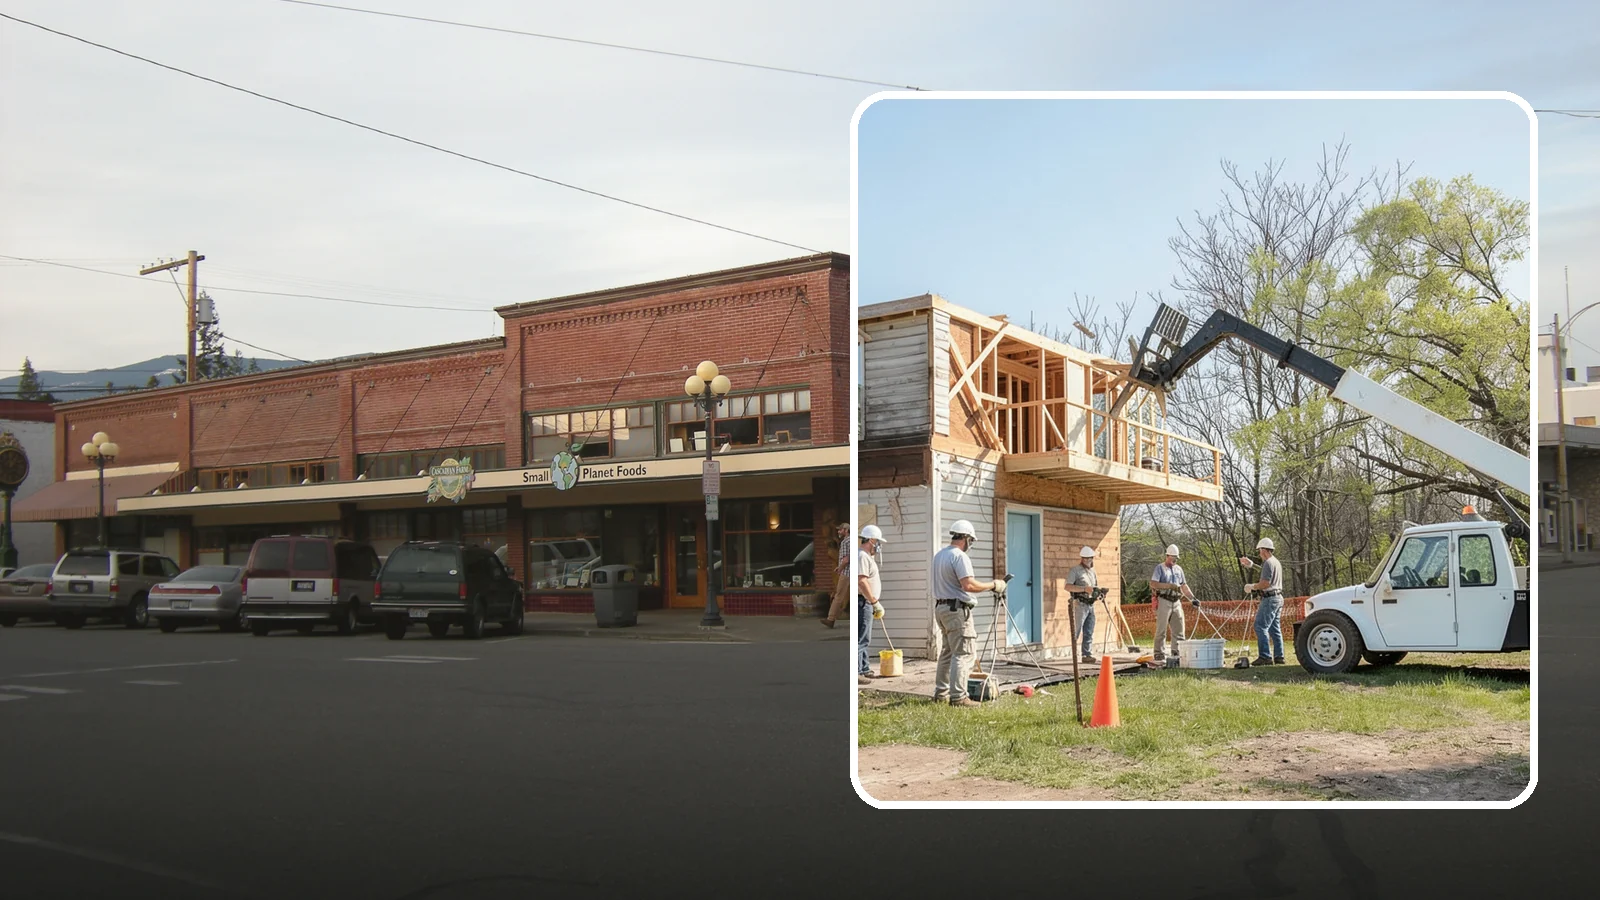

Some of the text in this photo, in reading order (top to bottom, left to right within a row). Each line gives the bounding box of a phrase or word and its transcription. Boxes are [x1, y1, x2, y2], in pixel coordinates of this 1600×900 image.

[456, 466, 469, 474] FARM
[523, 465, 646, 482] Small Planet Foods
